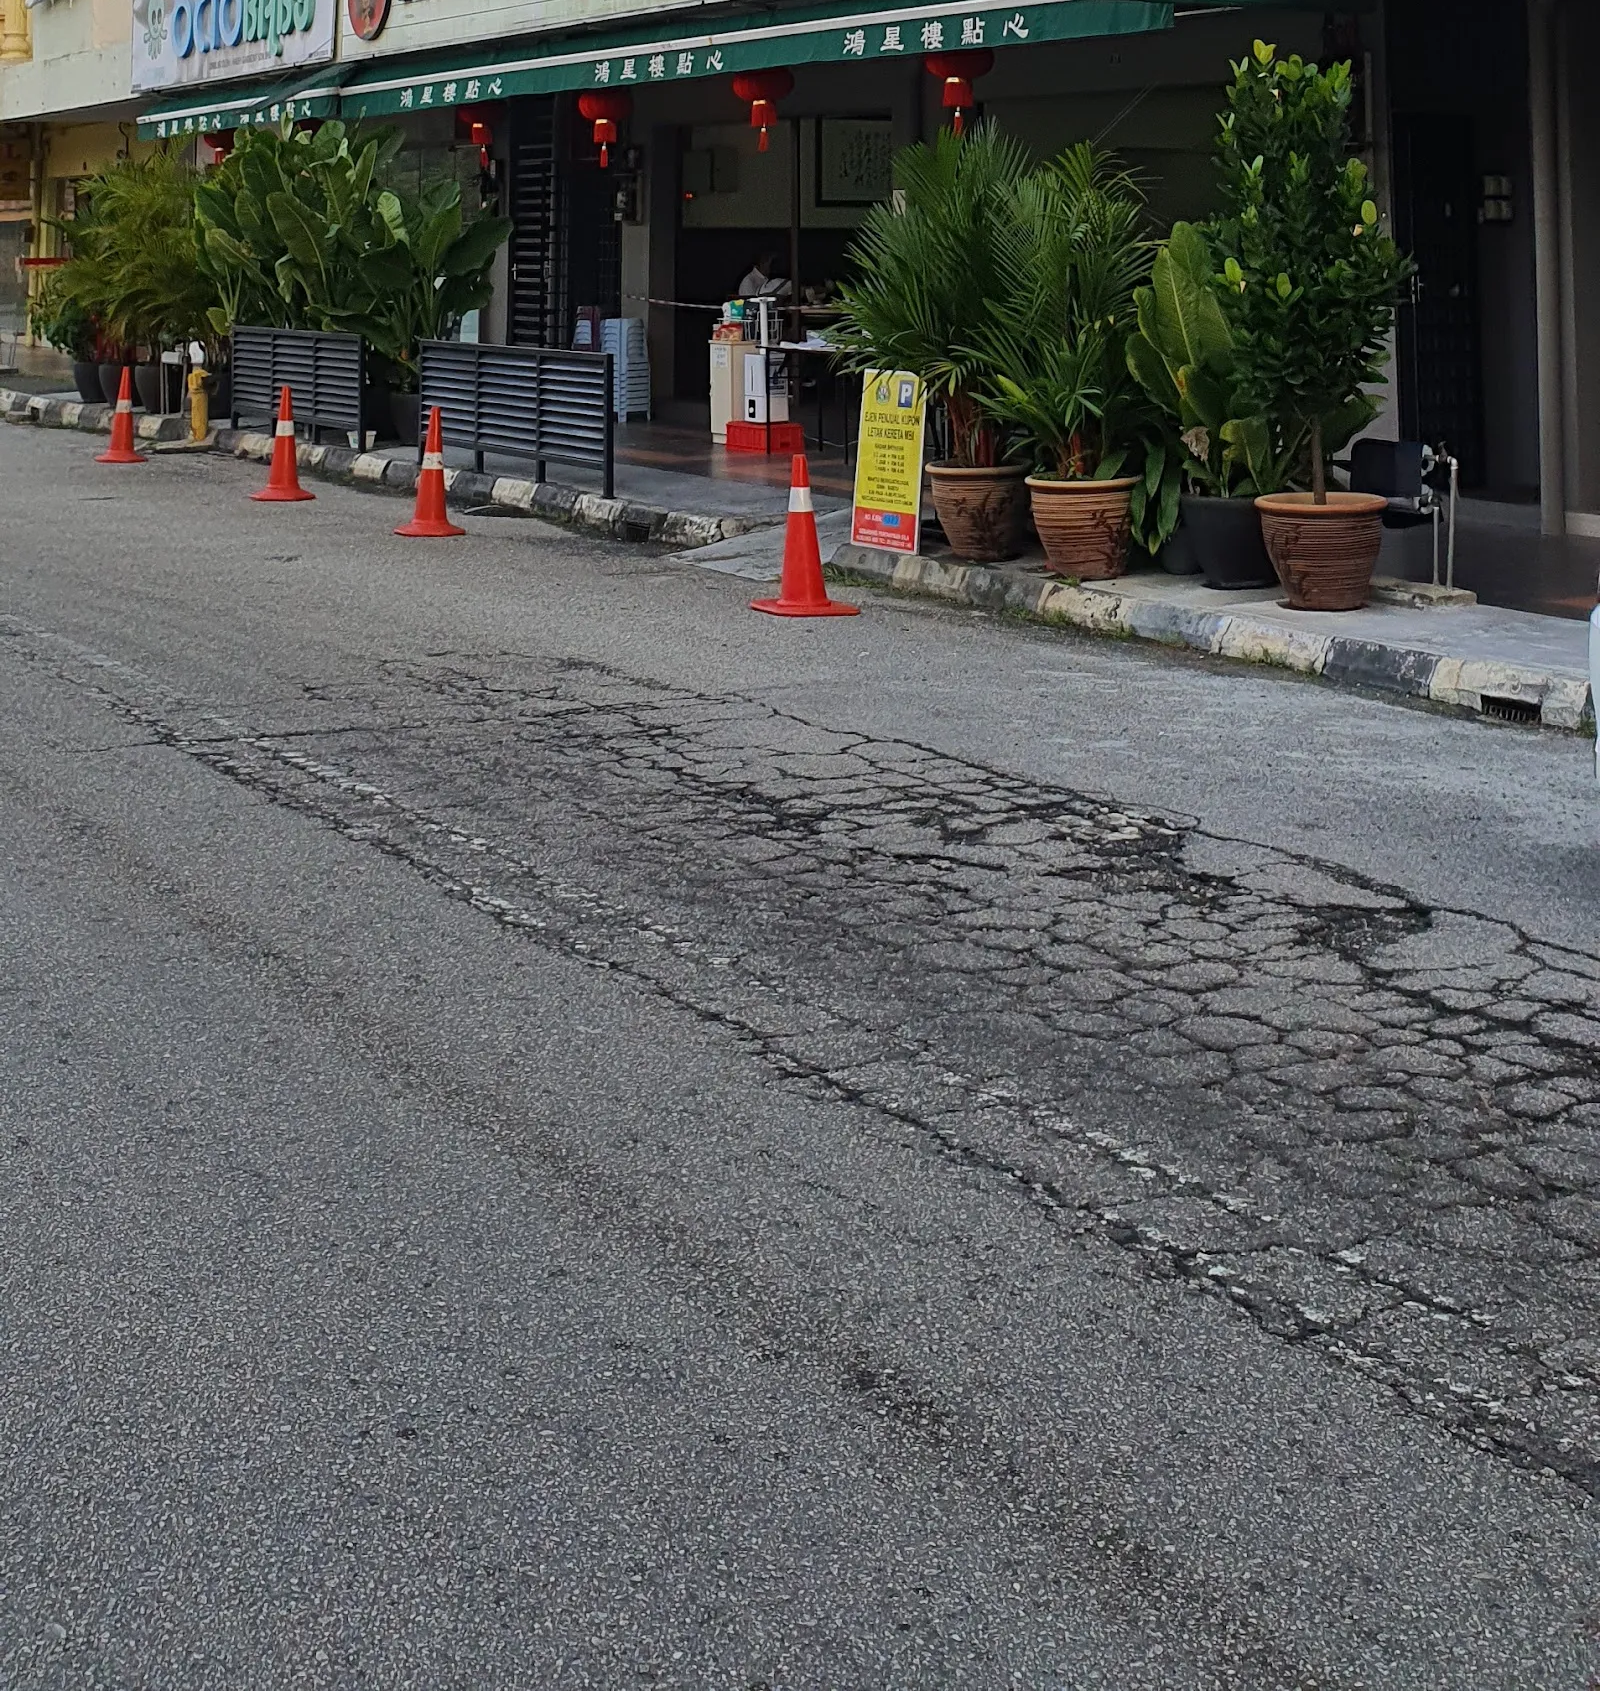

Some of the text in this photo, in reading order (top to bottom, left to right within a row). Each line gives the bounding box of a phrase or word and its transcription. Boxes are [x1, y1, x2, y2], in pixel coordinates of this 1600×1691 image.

[843, 13, 1029, 55] 鴻星樓點心
[595, 50, 723, 82] 鴻星樓點心
[400, 77, 502, 107] 鴻星樓點心
[901, 384, 912, 403] P
[884, 428, 903, 440] KERETA
